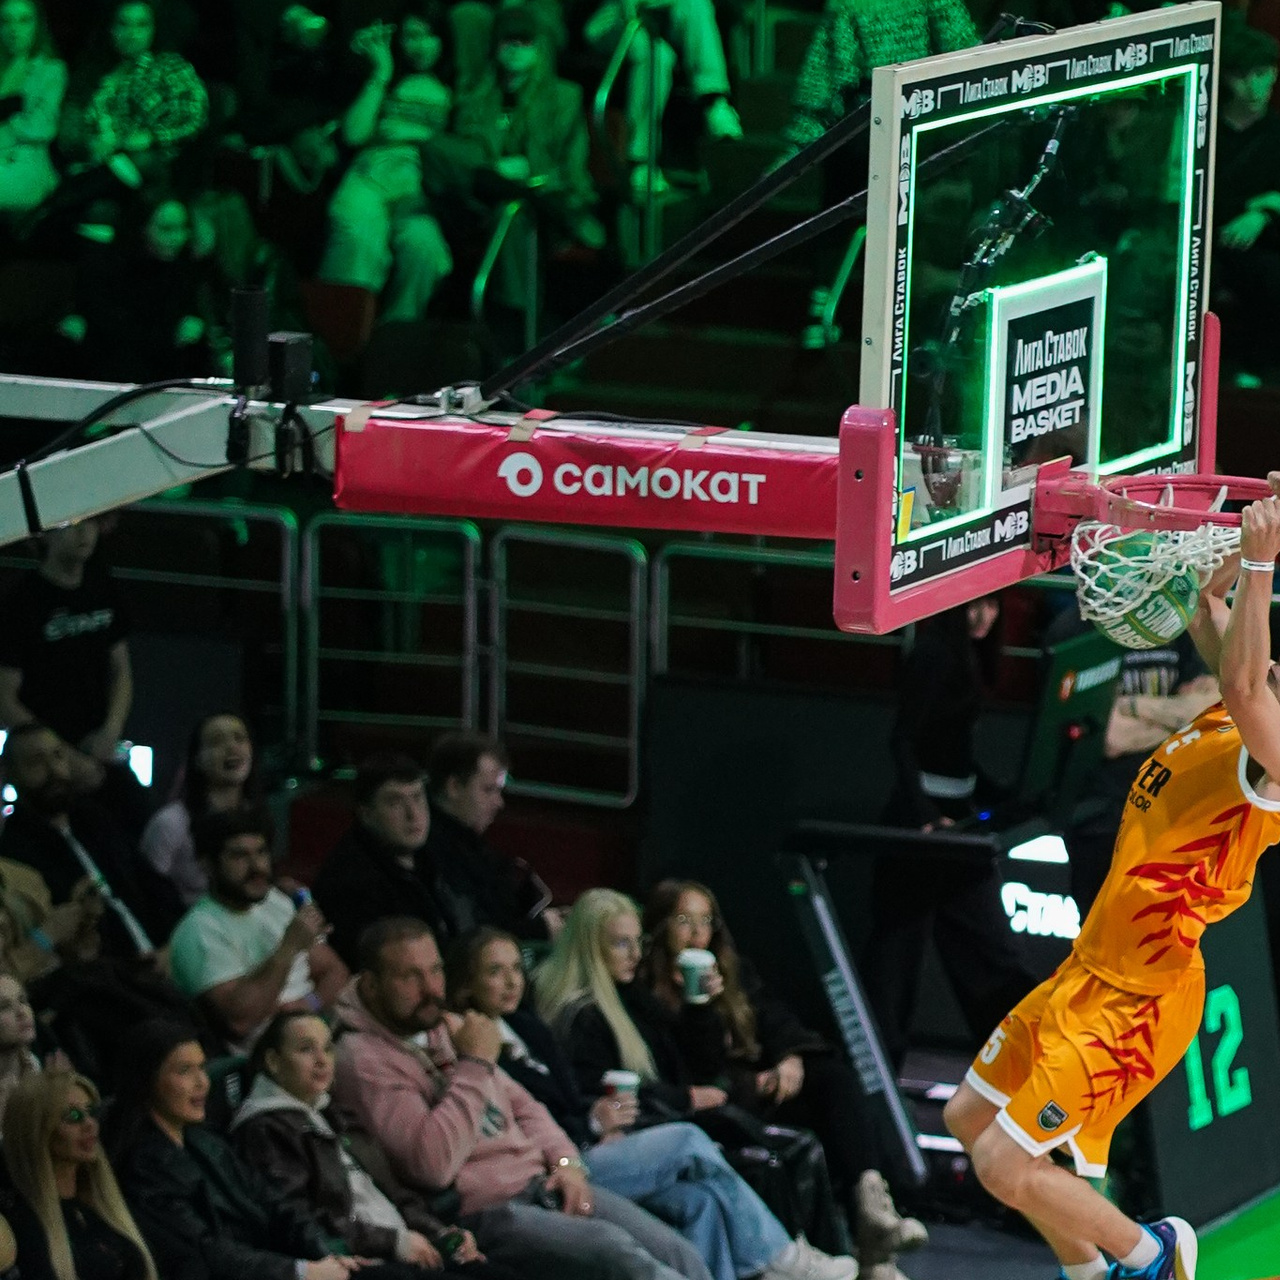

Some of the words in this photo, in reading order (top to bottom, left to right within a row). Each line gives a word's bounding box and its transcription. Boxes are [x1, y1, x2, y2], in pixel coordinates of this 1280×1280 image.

[1011, 365, 1085, 415] MEDIA
[1010, 399, 1085, 445] BASKET
[1185, 984, 1252, 1131] 12
